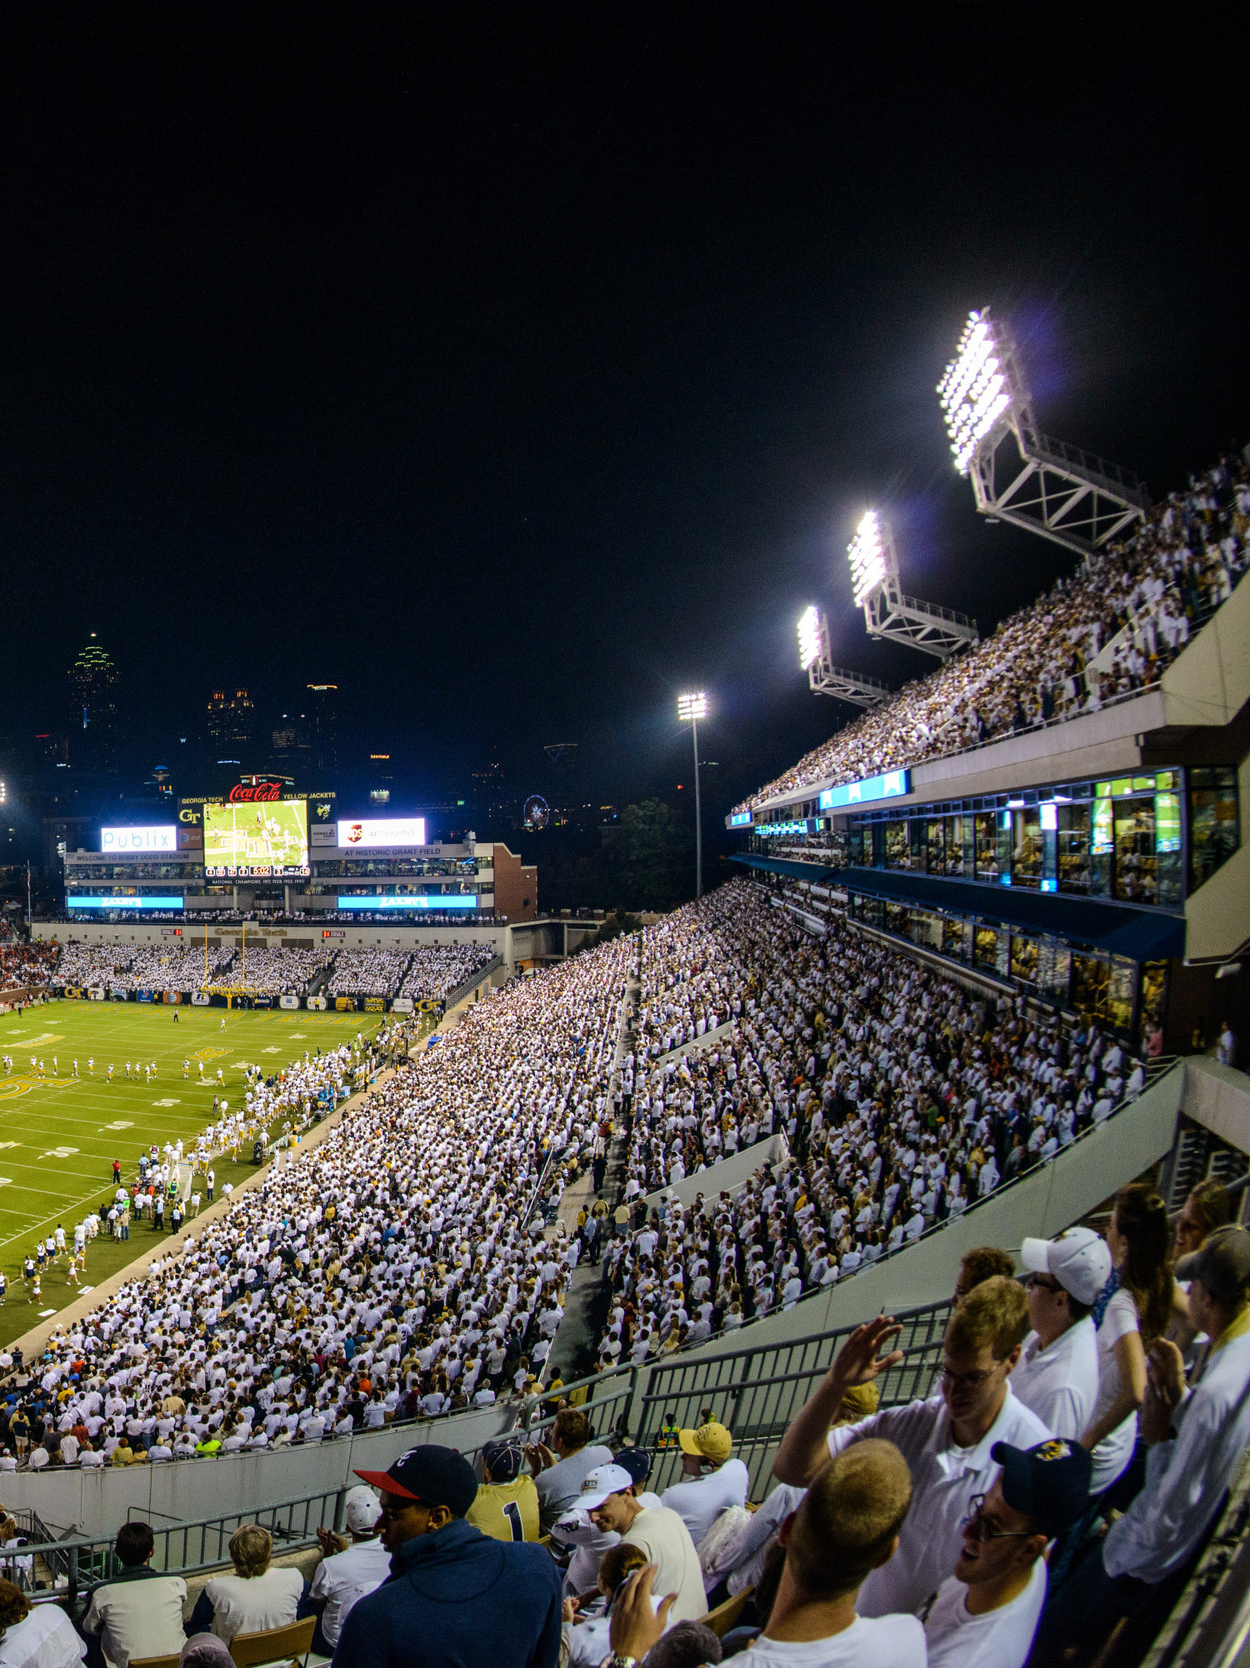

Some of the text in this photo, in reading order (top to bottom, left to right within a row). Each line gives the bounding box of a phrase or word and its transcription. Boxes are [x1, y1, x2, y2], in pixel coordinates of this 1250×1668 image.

[179, 809, 200, 824] GT
[103, 831, 169, 848] Publix
[355, 849, 391, 857] HISTORIC
[419, 847, 441, 855] FIELD
[214, 927, 288, 937] Georgia Tech
[44, 1146, 80, 1158] 30
[503, 1501, 525, 1542] 1
